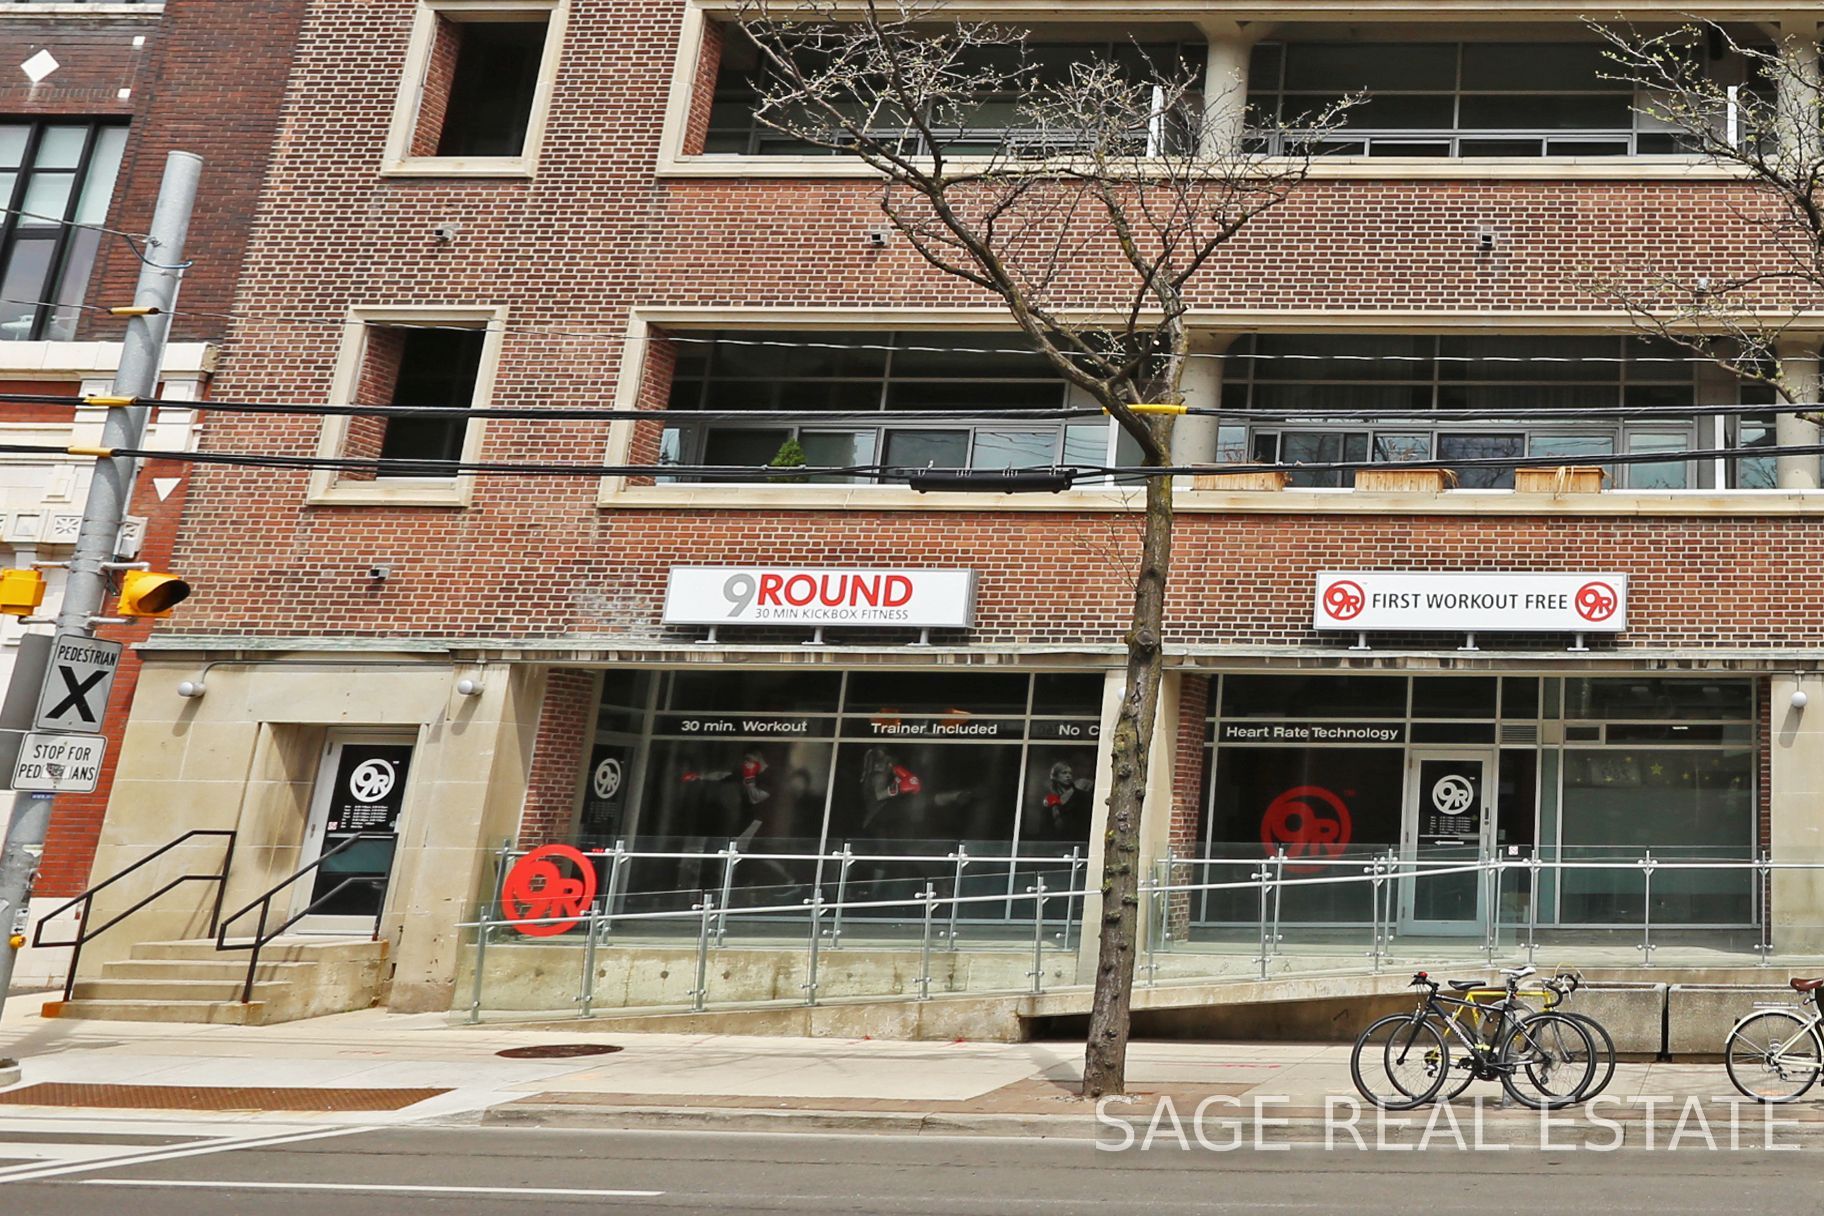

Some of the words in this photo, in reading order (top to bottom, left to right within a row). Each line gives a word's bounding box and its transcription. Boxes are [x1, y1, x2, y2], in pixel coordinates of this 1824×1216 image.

[1372, 592, 1421, 609] FIRST
[1426, 592, 1518, 609] WORKOUT
[1525, 593, 1568, 610] FREE
[755, 608, 770, 618] 30
[773, 608, 798, 619] MIN
[802, 609, 858, 620] KICKBOX
[861, 609, 909, 620] FITNESS
[57, 645, 118, 666] PEDESTRIAN
[681, 720, 699, 732] 30
[704, 720, 736, 732] min.
[742, 720, 808, 733] Workout
[871, 722, 926, 735] Trainer
[932, 723, 998, 735] Included
[1058, 724, 1080, 736] No
[1226, 726, 1269, 737] Heart
[1273, 726, 1309, 738] Rate
[1312, 727, 1399, 741] Technology
[33, 744, 64, 760] STOP
[67, 746, 91, 761] FOR
